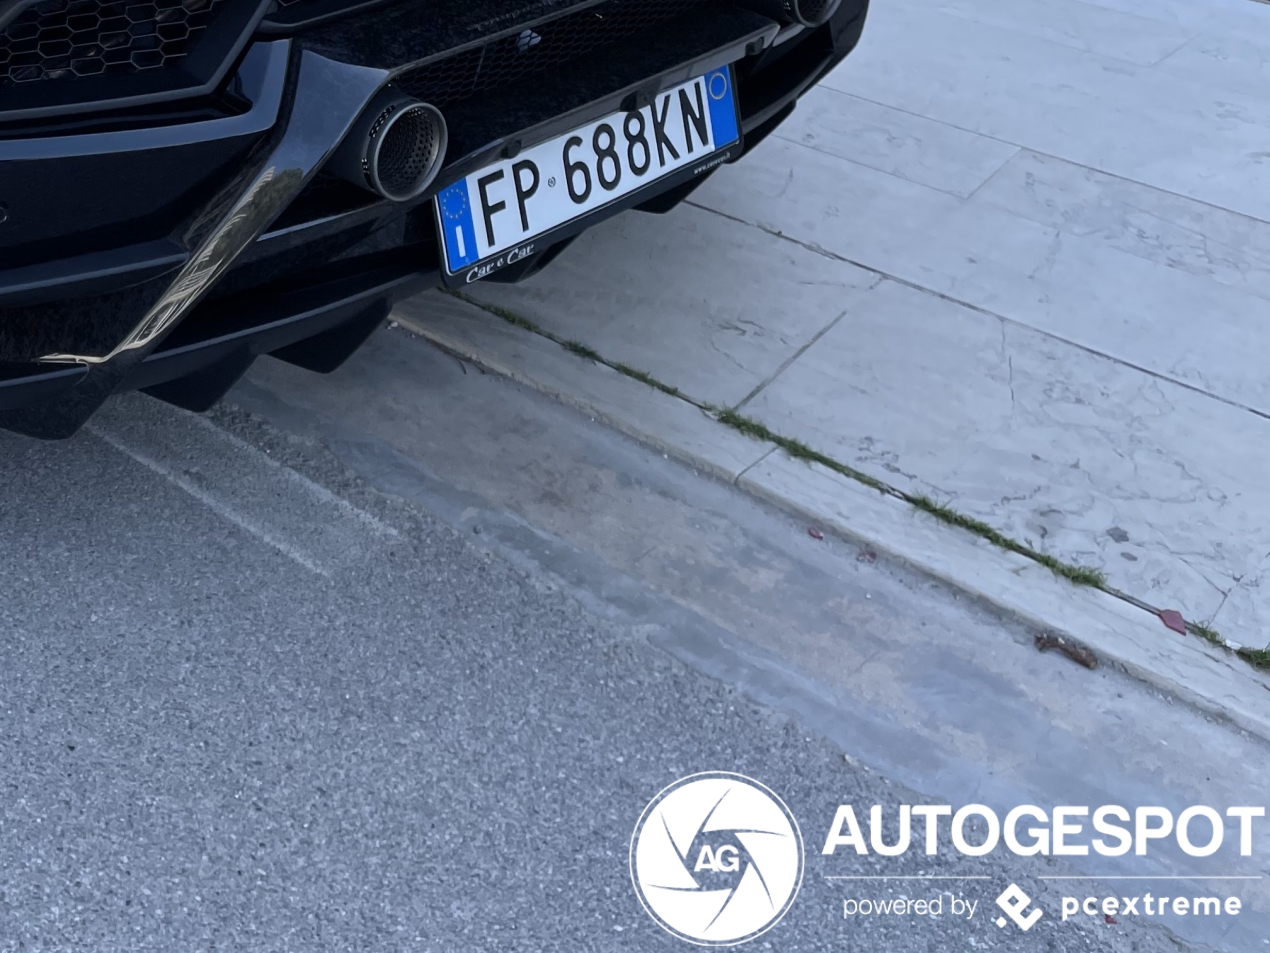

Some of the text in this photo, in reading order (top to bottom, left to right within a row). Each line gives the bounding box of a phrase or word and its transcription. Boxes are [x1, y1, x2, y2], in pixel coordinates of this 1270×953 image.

[477, 81, 709, 248] FP 688KN
[466, 265, 495, 284] Car
[507, 244, 535, 265] Car
